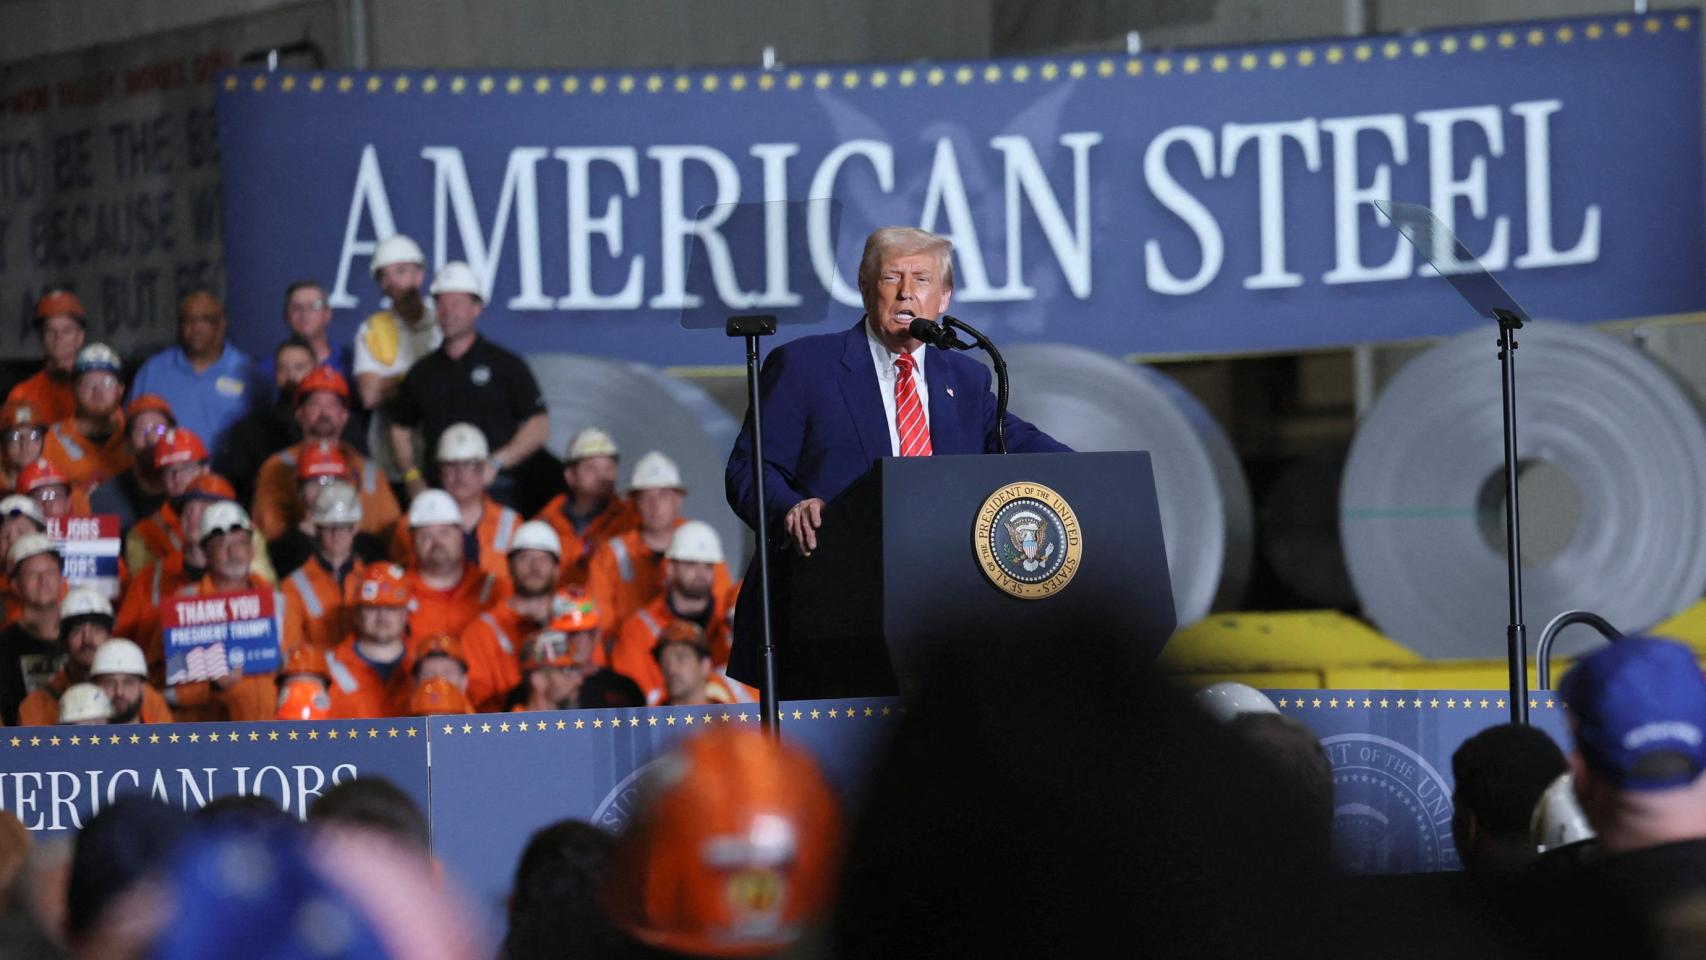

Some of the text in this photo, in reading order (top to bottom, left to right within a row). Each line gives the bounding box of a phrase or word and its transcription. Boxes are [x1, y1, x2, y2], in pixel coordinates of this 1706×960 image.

[108, 111, 174, 182] THE
[31, 190, 175, 268] BECAUSE
[329, 99, 1600, 311] AMERICAN STEEL
[66, 516, 100, 541] JOBS
[979, 486, 1079, 593] SEAL OF THE PRESIDENT OF THE UNITED STATES
[62, 556, 97, 577] JOBS
[176, 594, 261, 626] THANK YOU
[1359, 746, 1381, 762] OF
[1385, 752, 1417, 780] THE
[0, 768, 218, 831] ERICAN
